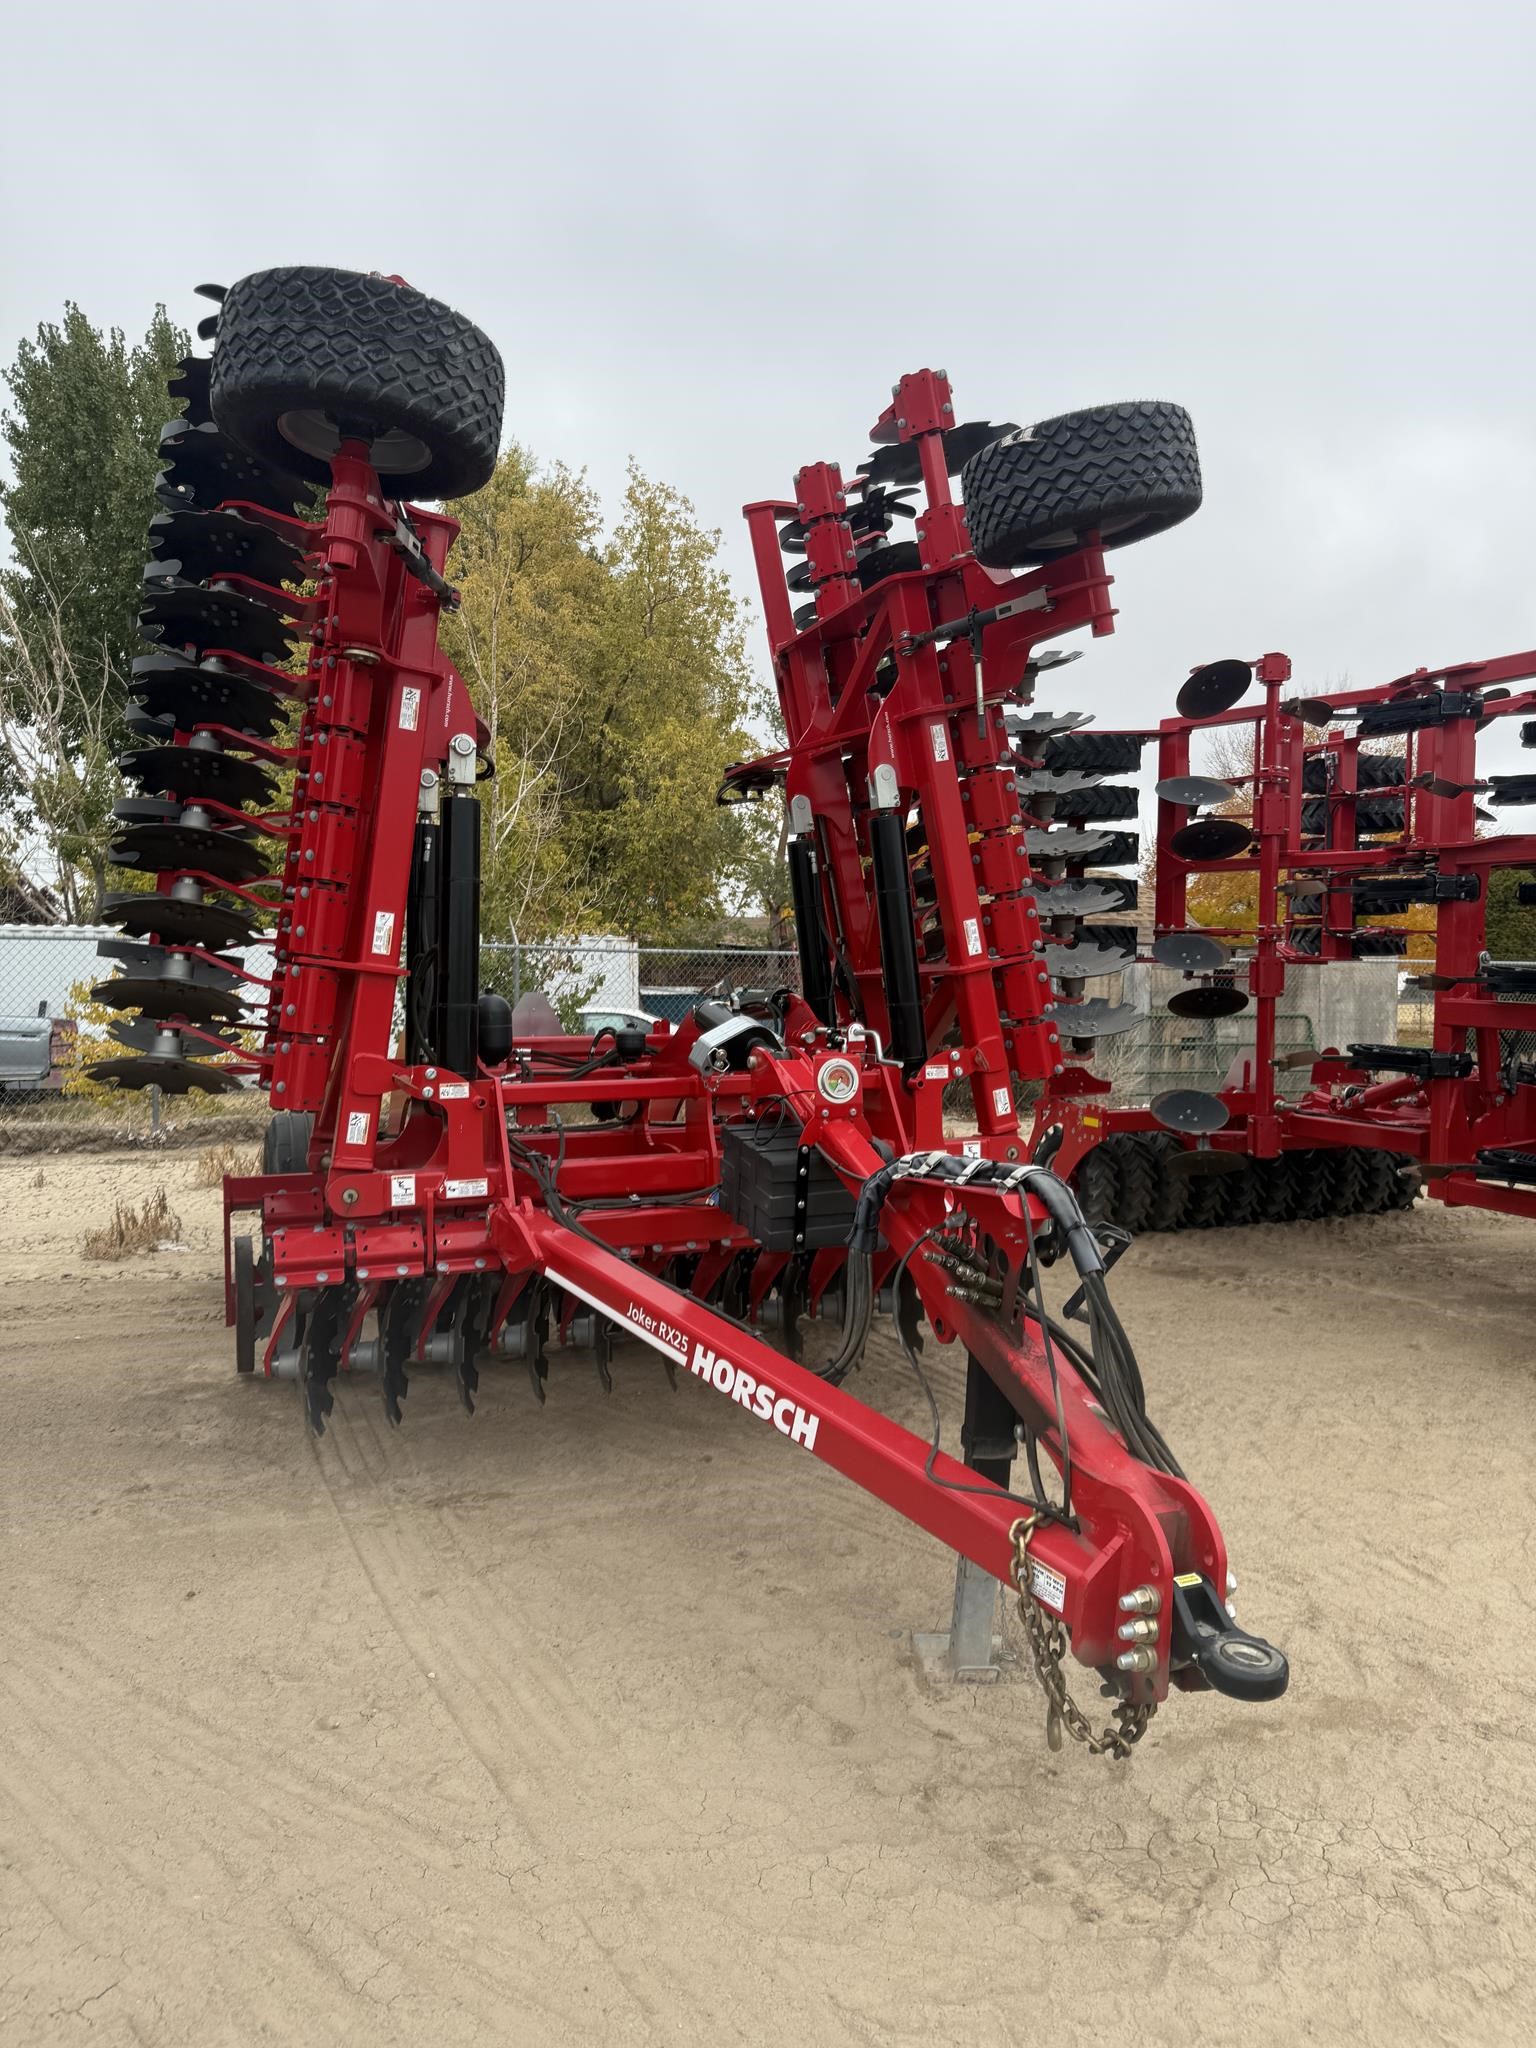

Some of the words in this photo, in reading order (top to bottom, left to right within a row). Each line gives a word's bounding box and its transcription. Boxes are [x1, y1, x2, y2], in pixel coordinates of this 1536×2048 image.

[626, 1302, 658, 1333] Joker
[658, 1321, 689, 1352] RX25
[691, 1342, 820, 1451] HORSCH
